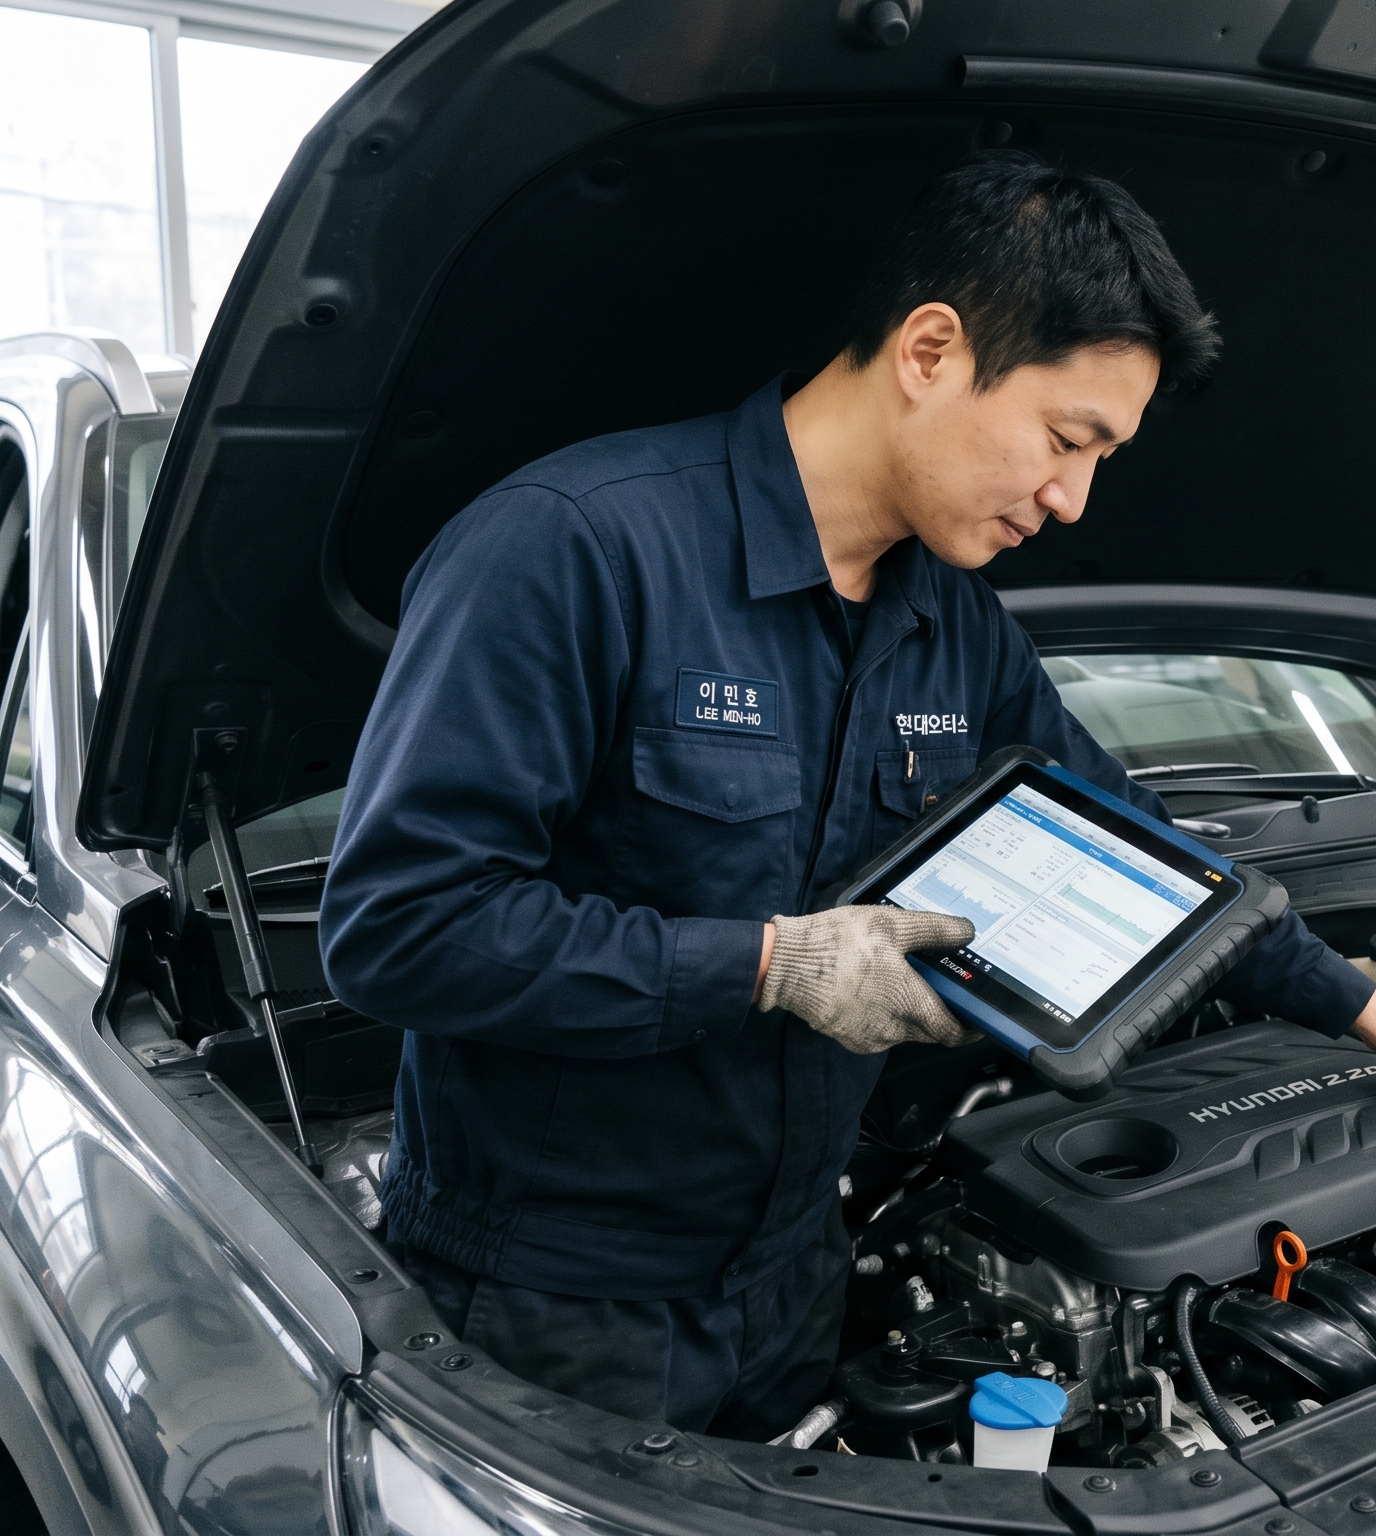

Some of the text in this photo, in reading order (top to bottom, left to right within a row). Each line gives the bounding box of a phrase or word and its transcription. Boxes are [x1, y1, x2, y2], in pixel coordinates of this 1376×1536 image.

[696, 706, 719, 721] LEE
[895, 713, 968, 735] 현대오티스
[1188, 1078, 1323, 1123] HYUNDAI
